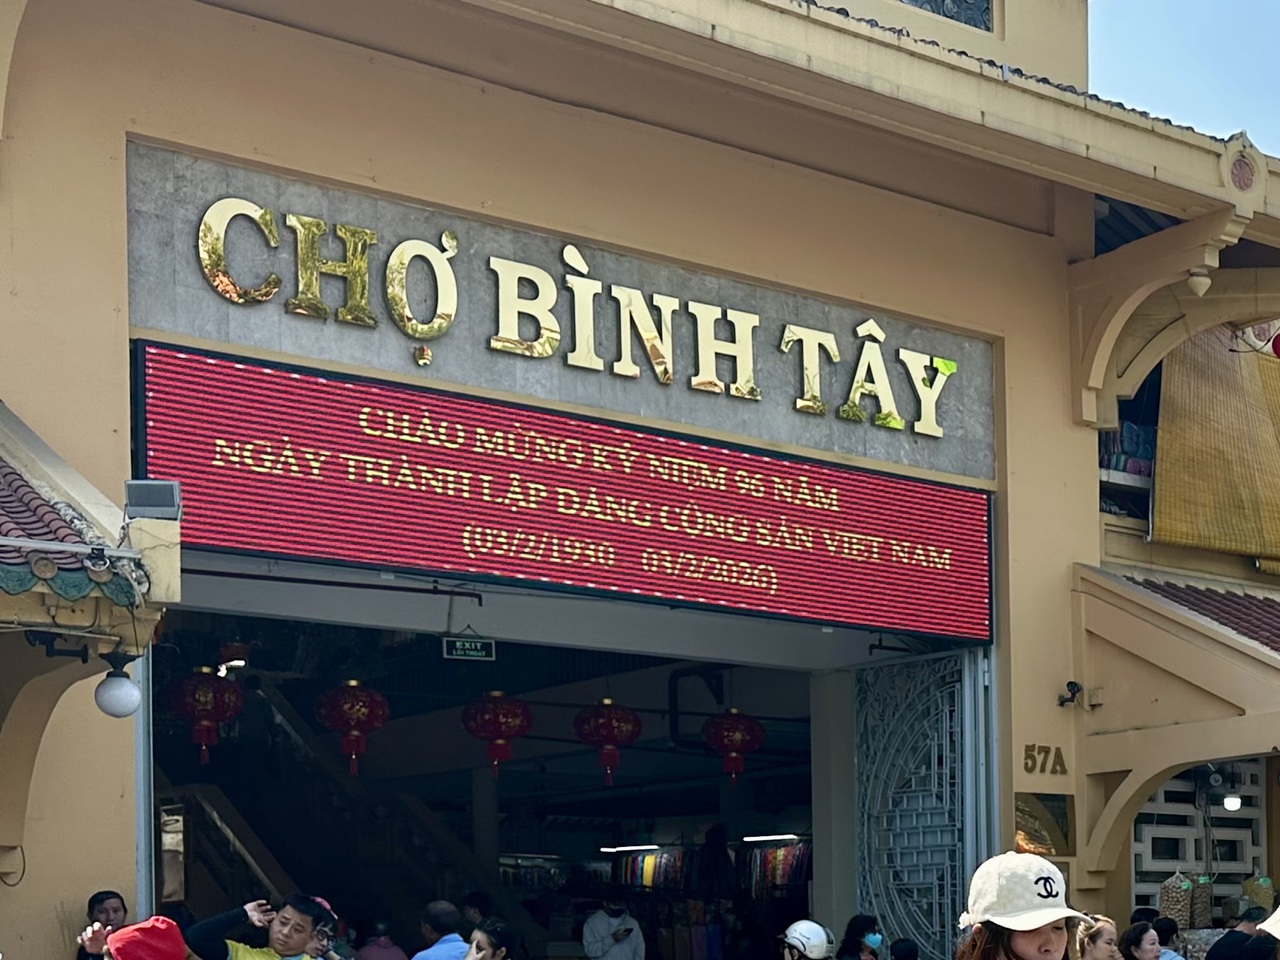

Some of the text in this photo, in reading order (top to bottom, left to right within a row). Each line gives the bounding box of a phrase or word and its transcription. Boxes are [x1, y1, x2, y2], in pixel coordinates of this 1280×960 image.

[197, 197, 957, 438] CHỢ BÌNH TÂY
[734, 469, 765, 498] 96
[211, 437, 331, 480] NGÀY
[890, 540, 953, 570] NAM
[456, 641, 482, 650] EXIT
[1024, 743, 1068, 775] 57A
